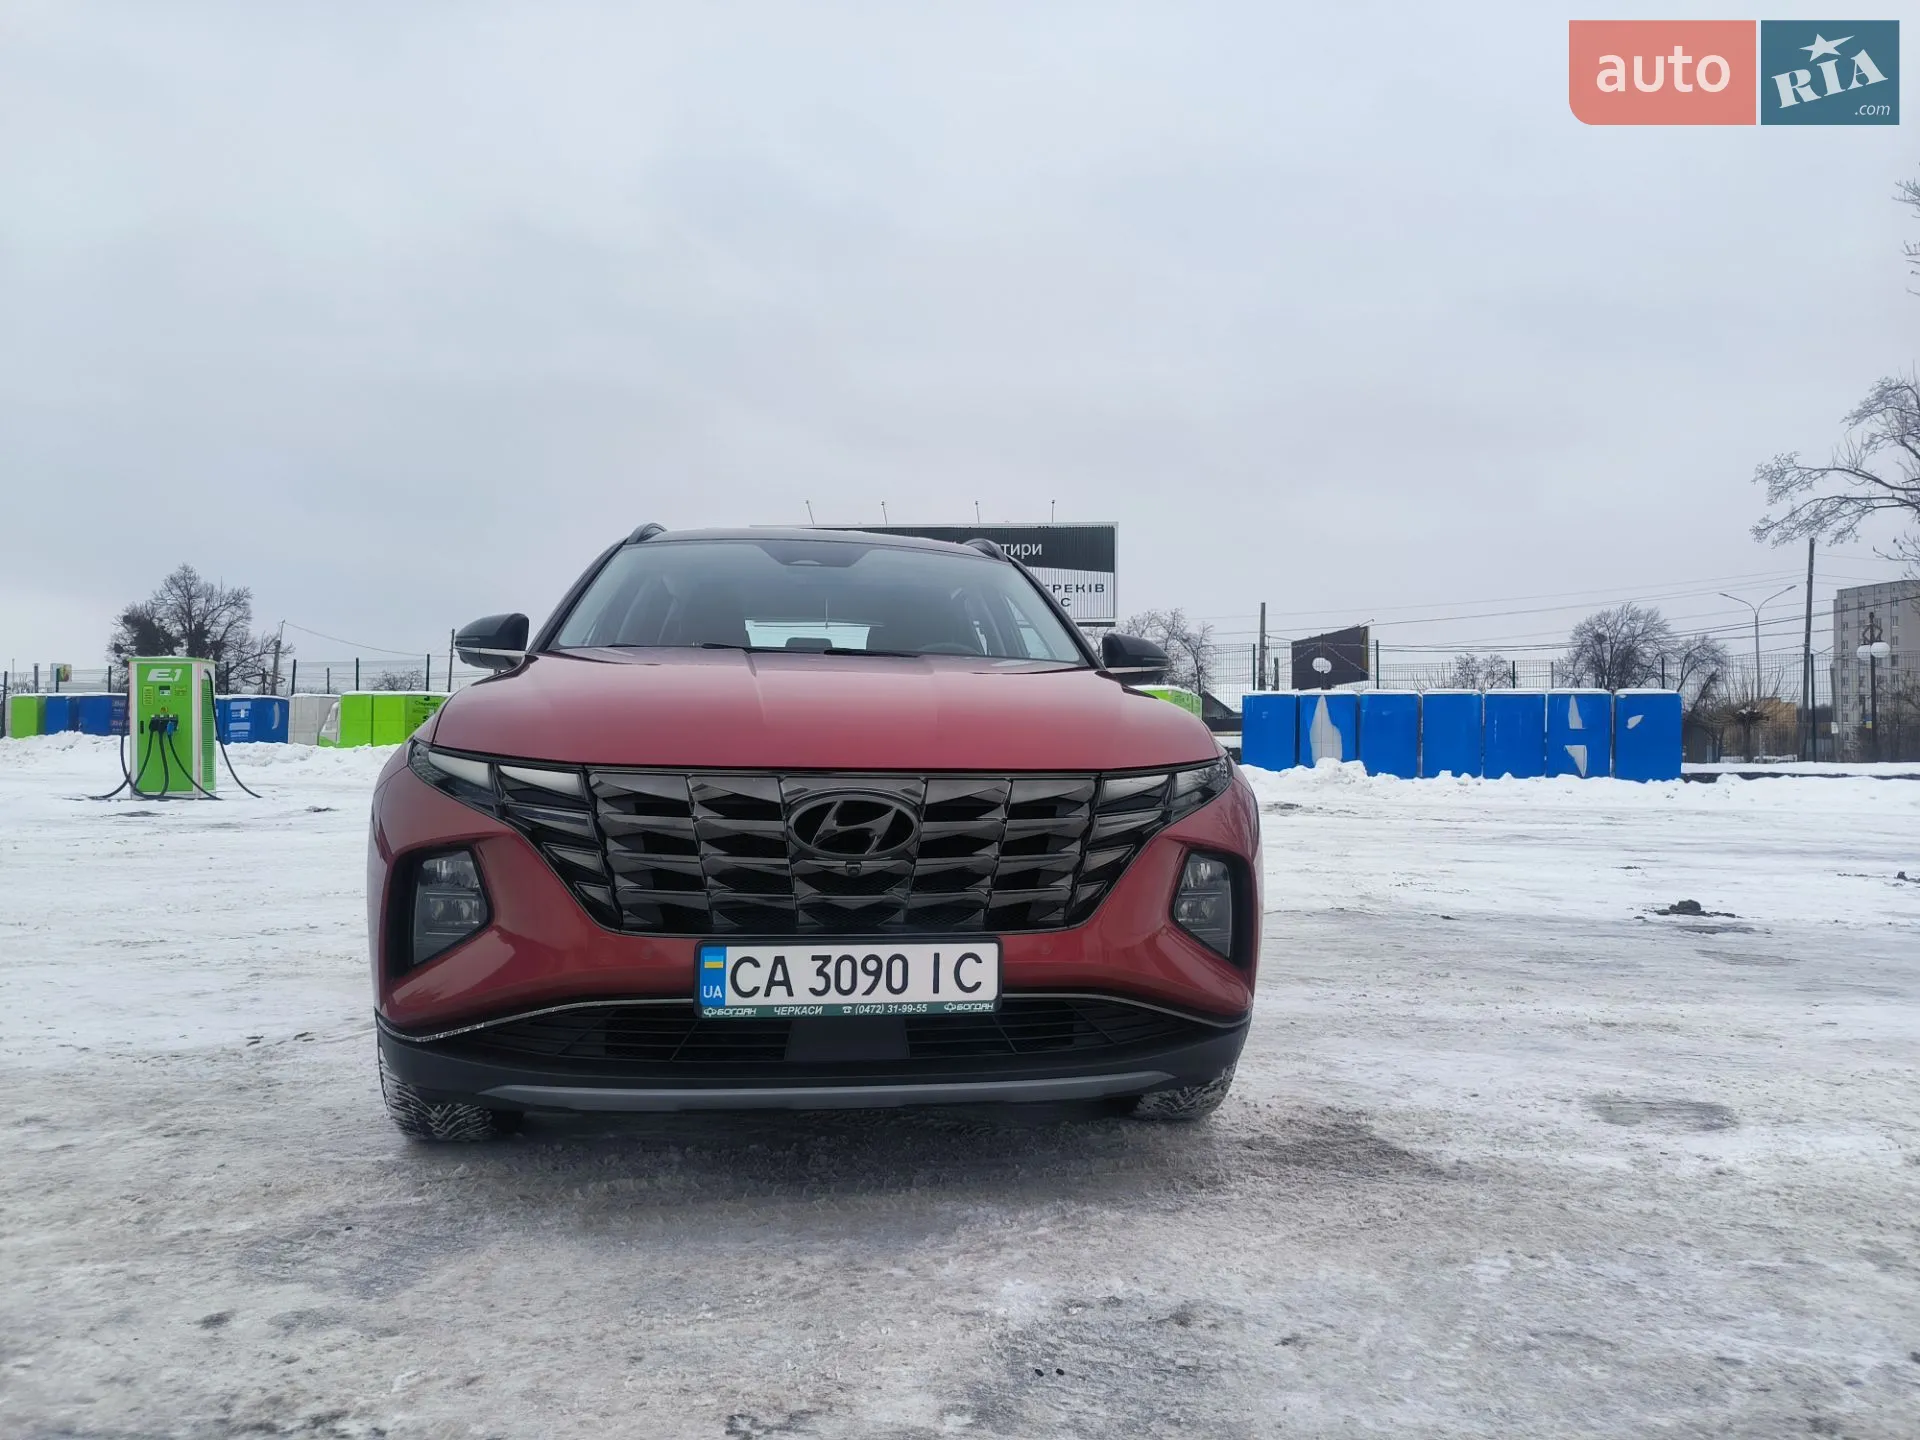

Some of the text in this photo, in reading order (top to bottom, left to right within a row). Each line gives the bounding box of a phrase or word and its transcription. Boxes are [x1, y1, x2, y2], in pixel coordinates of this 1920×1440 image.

[730, 952, 983, 998] CA 3090 IC
[703, 985, 723, 998] UA
[774, 1006, 823, 1015] ЧЕРКАСИ
[855, 1003, 928, 1015] (0472) 31-99-55
